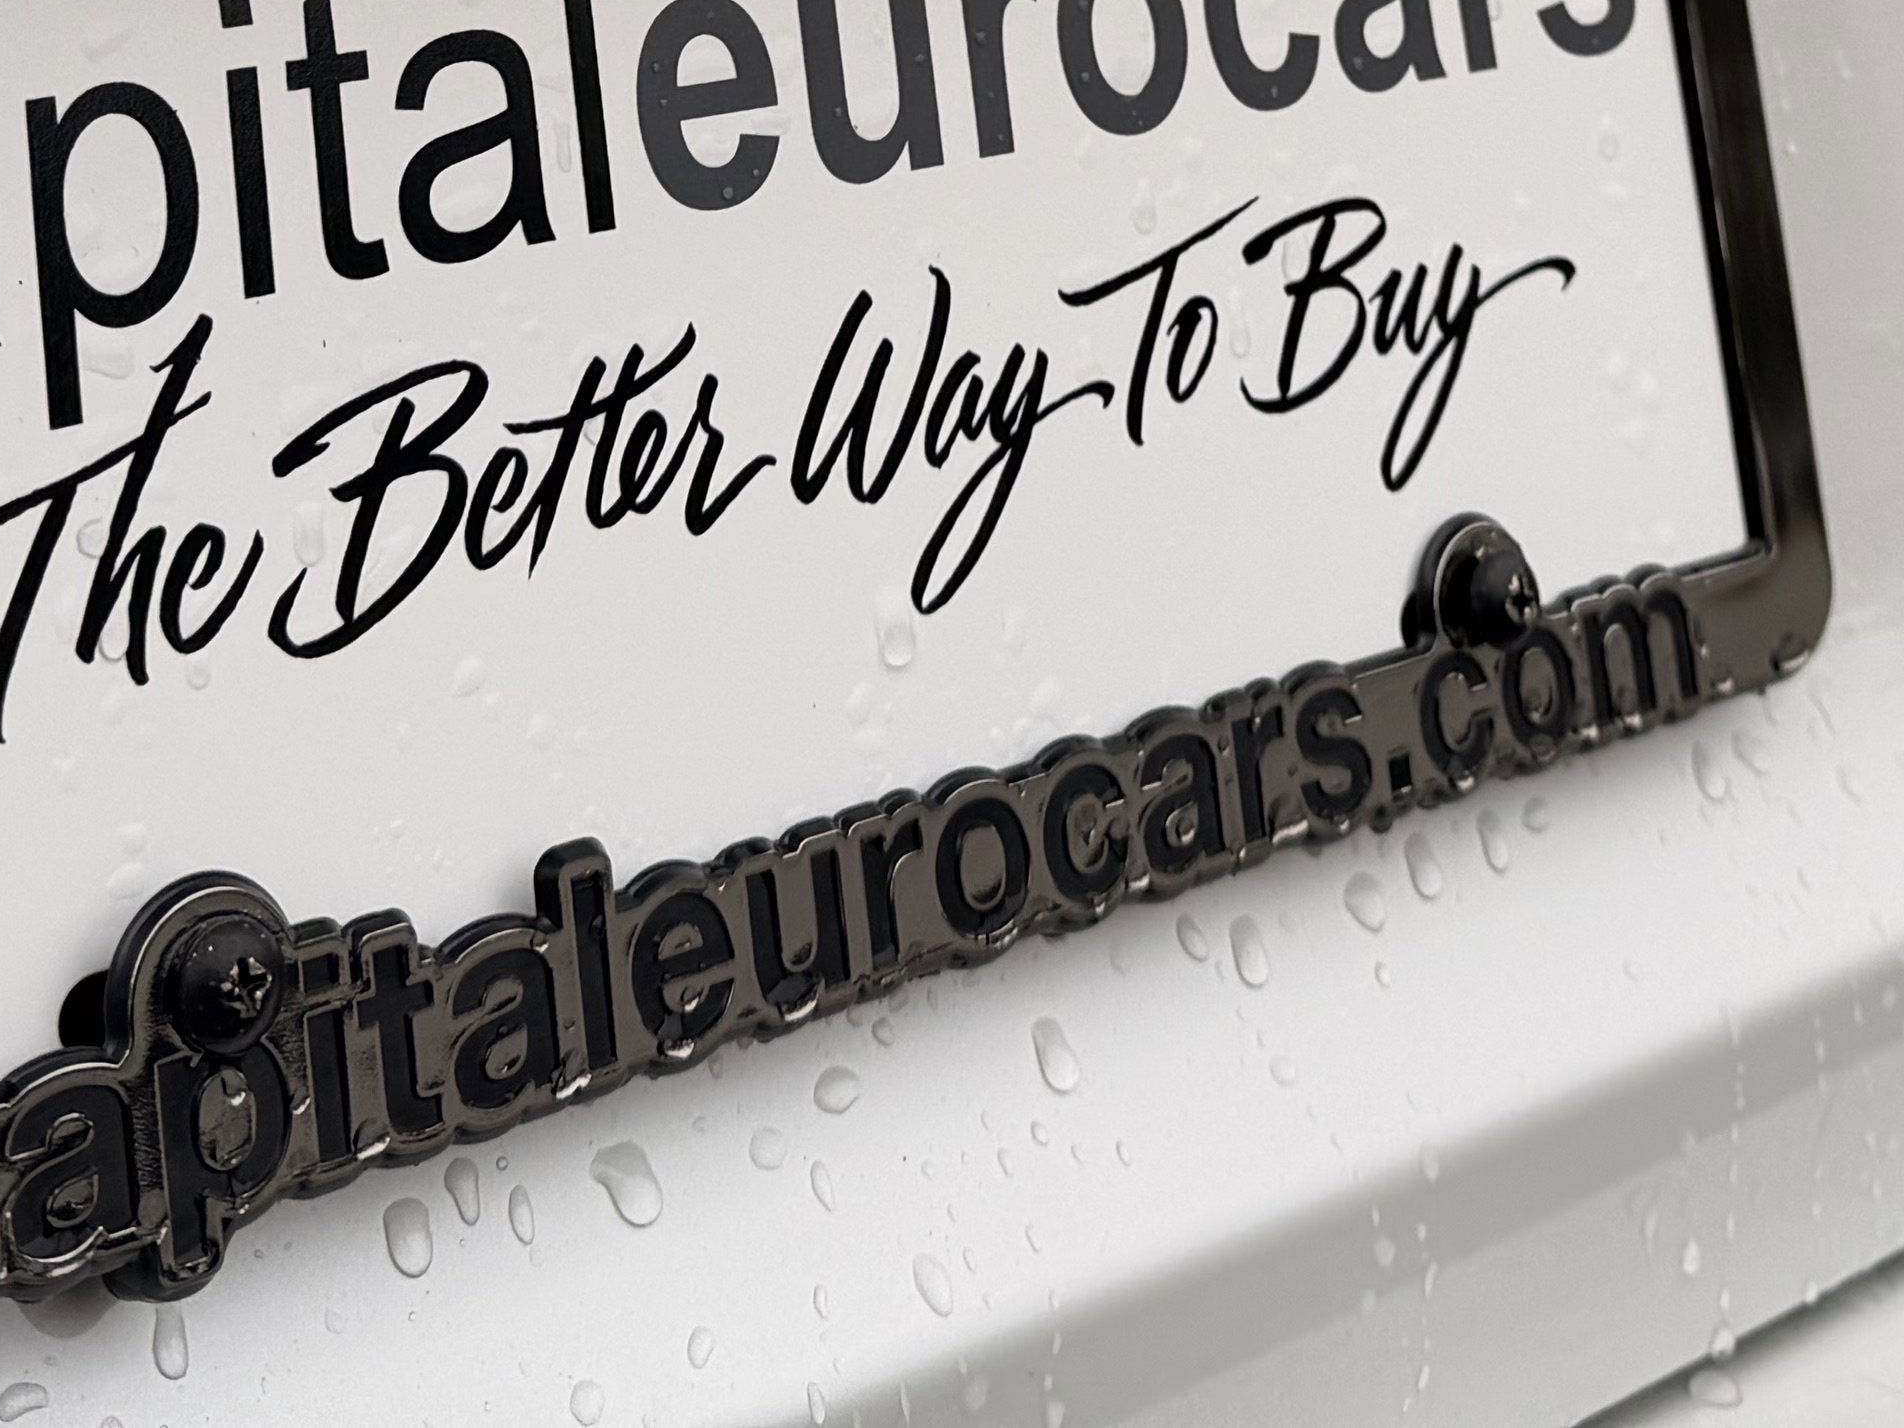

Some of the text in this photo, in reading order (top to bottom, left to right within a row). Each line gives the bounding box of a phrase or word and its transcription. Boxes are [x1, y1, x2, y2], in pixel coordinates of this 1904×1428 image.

[268, 322, 776, 658] Better
[791, 265, 1114, 614] Way
[1058, 195, 1259, 445] To
[1239, 195, 1576, 491] Buy
